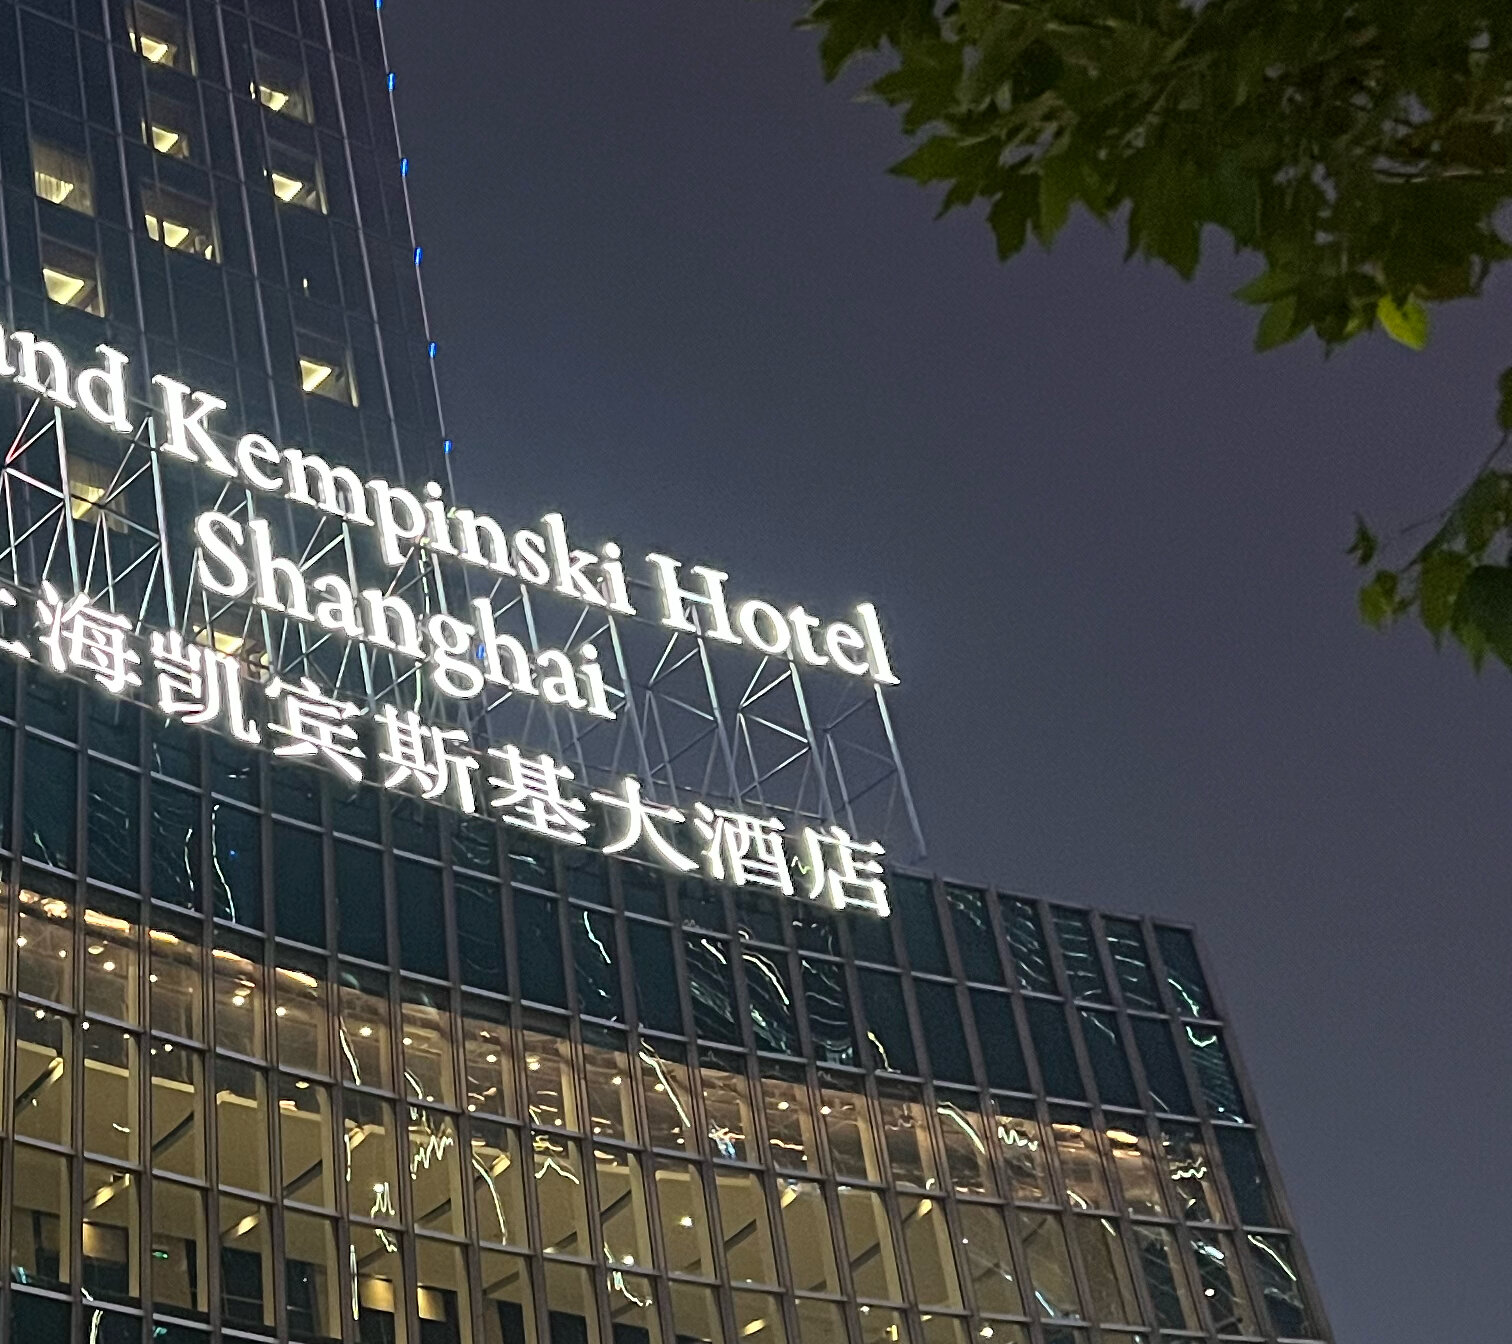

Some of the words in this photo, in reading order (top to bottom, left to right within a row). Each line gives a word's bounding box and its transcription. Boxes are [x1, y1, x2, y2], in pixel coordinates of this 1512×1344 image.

[151, 374, 637, 616] Kempinski
[645, 551, 901, 686] Hotel
[197, 511, 625, 720] Shanghai
